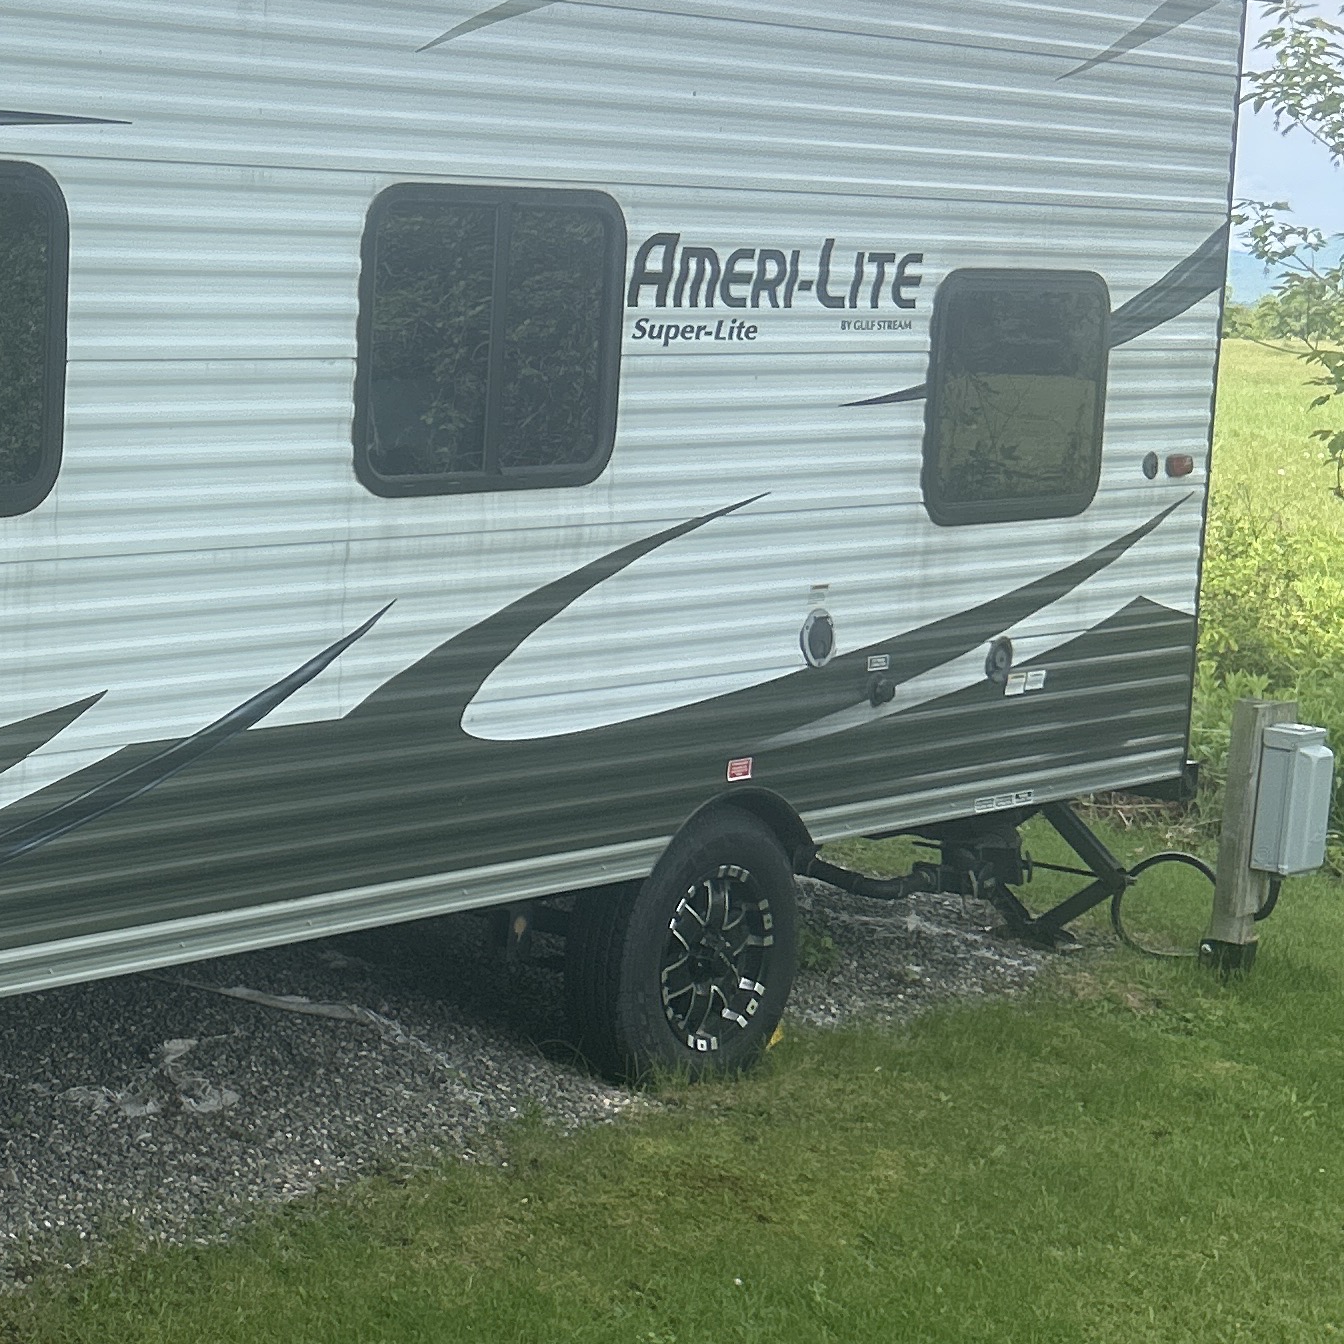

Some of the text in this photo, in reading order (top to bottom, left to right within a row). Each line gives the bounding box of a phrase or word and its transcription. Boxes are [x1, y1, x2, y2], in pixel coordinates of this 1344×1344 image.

[627, 232, 924, 309] AMERI-LITE
[631, 318, 759, 347] Super-Lite
[840, 319, 913, 331] BY GULF STREAM
